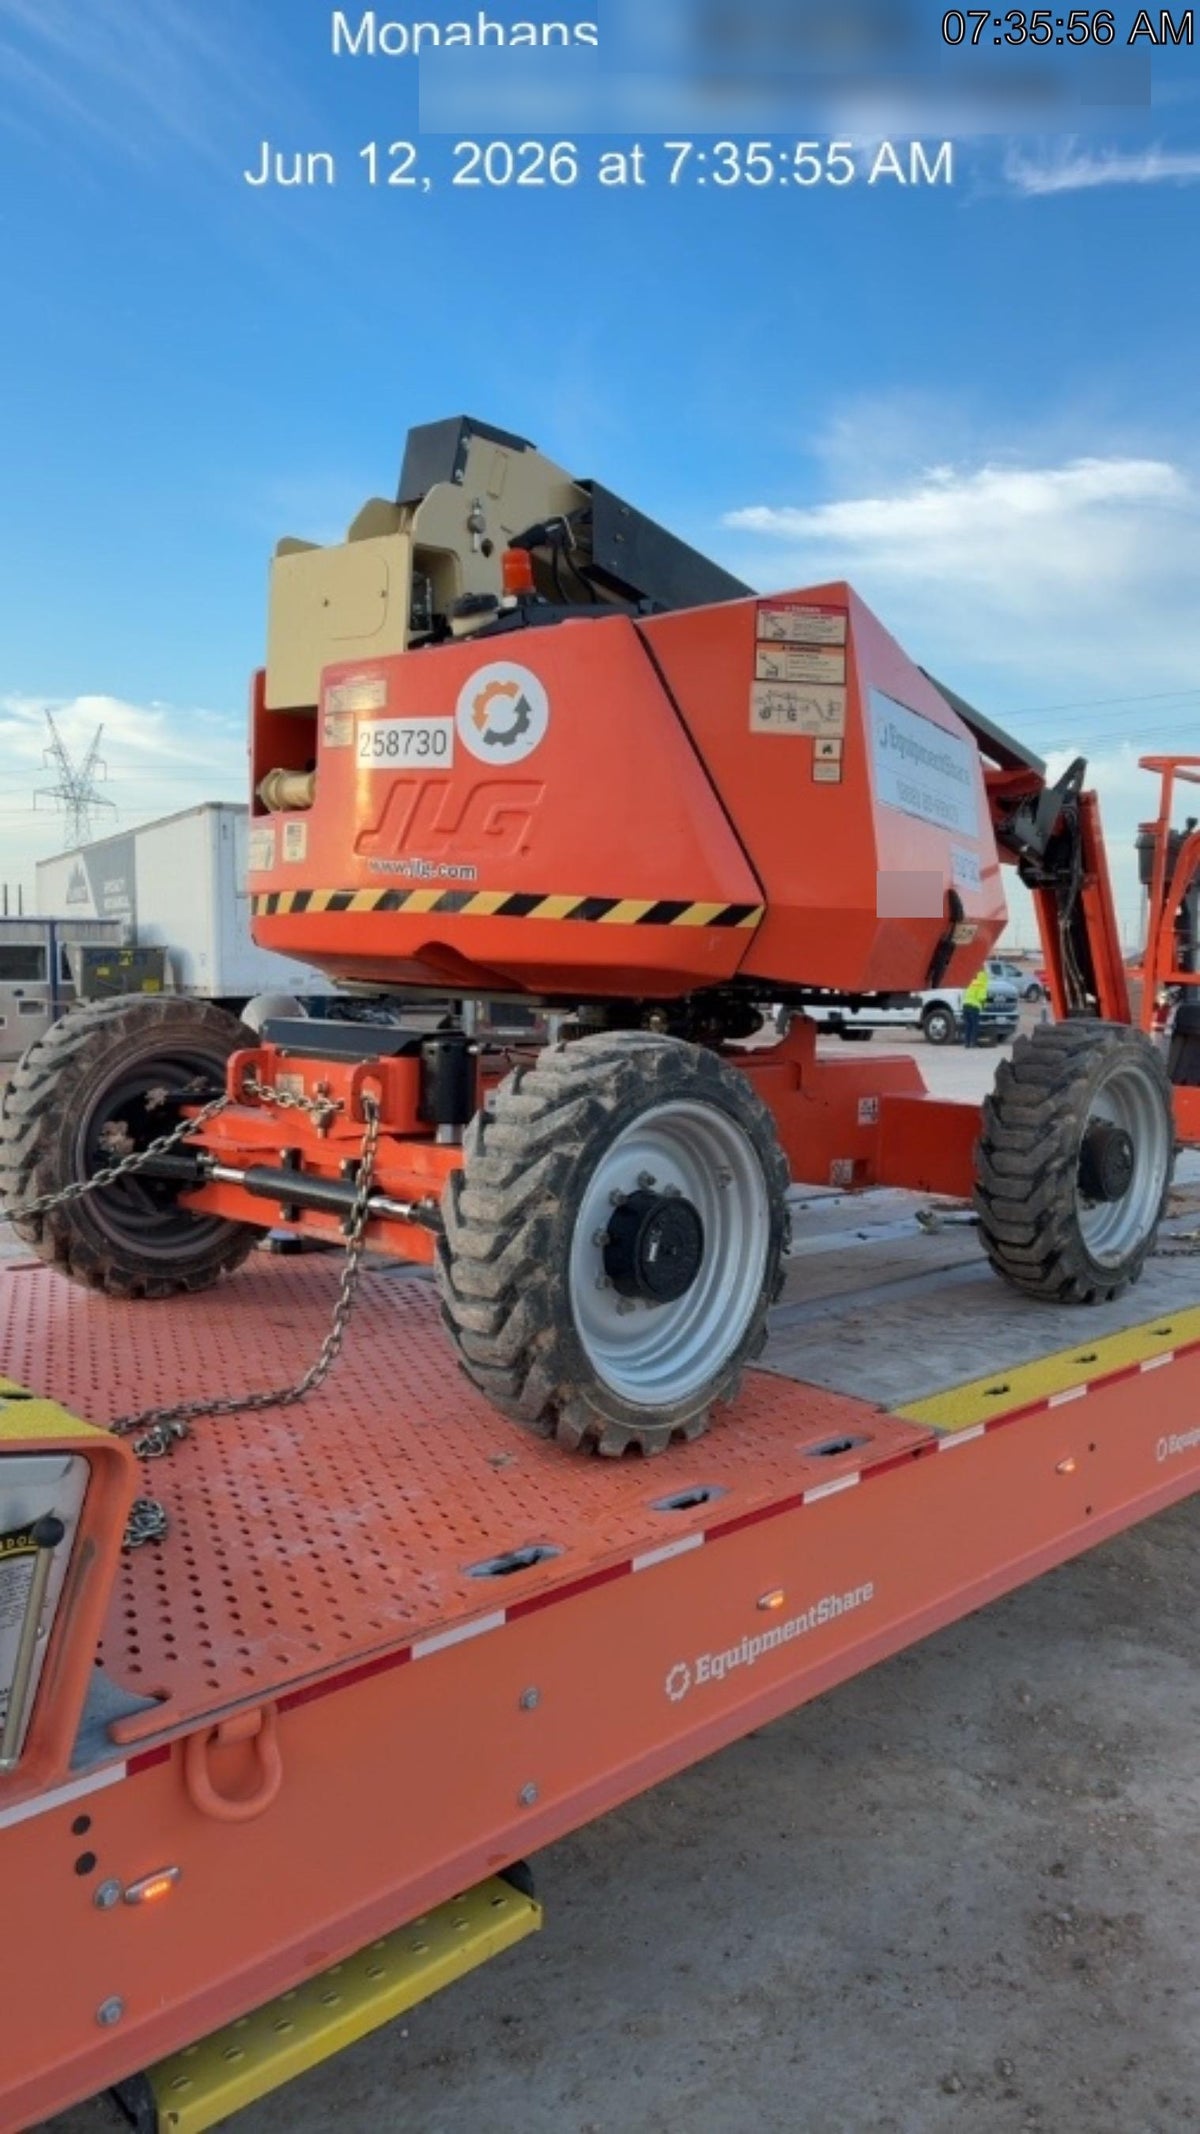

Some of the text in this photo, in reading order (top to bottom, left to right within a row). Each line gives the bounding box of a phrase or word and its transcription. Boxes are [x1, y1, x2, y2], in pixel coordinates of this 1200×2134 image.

[360, 729, 447, 757] 258730
[354, 779, 546, 857] JLG
[370, 857, 477, 881] www.jlg.com
[694, 1581, 874, 1685] EquipmentShare
